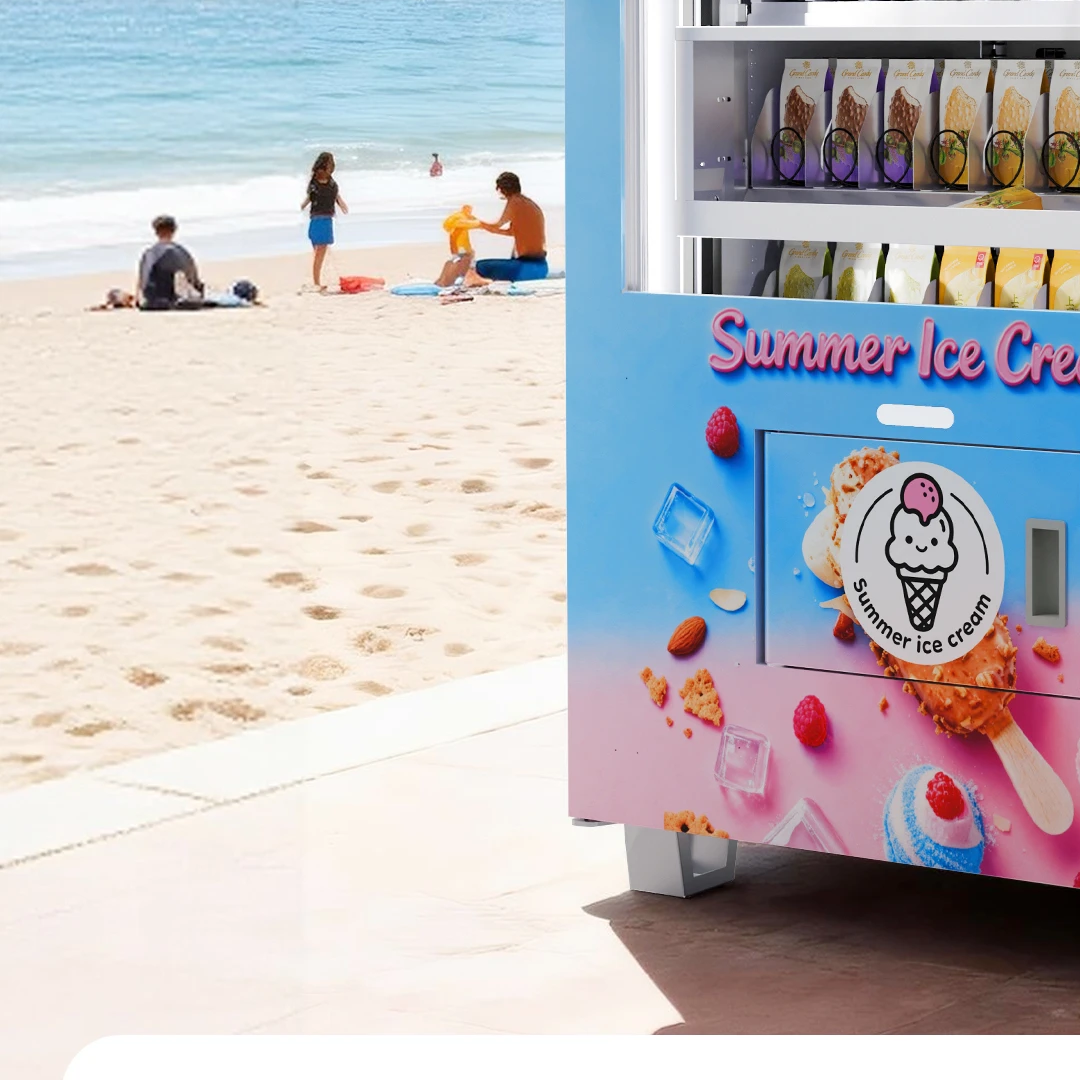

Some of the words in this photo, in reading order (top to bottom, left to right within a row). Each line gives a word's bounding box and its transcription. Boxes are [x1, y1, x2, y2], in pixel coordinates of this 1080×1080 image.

[709, 308, 910, 376] Summer
[918, 317, 986, 381] Ice
[853, 577, 912, 649] Summer
[916, 634, 943, 654] ice
[947, 593, 992, 648] cream
